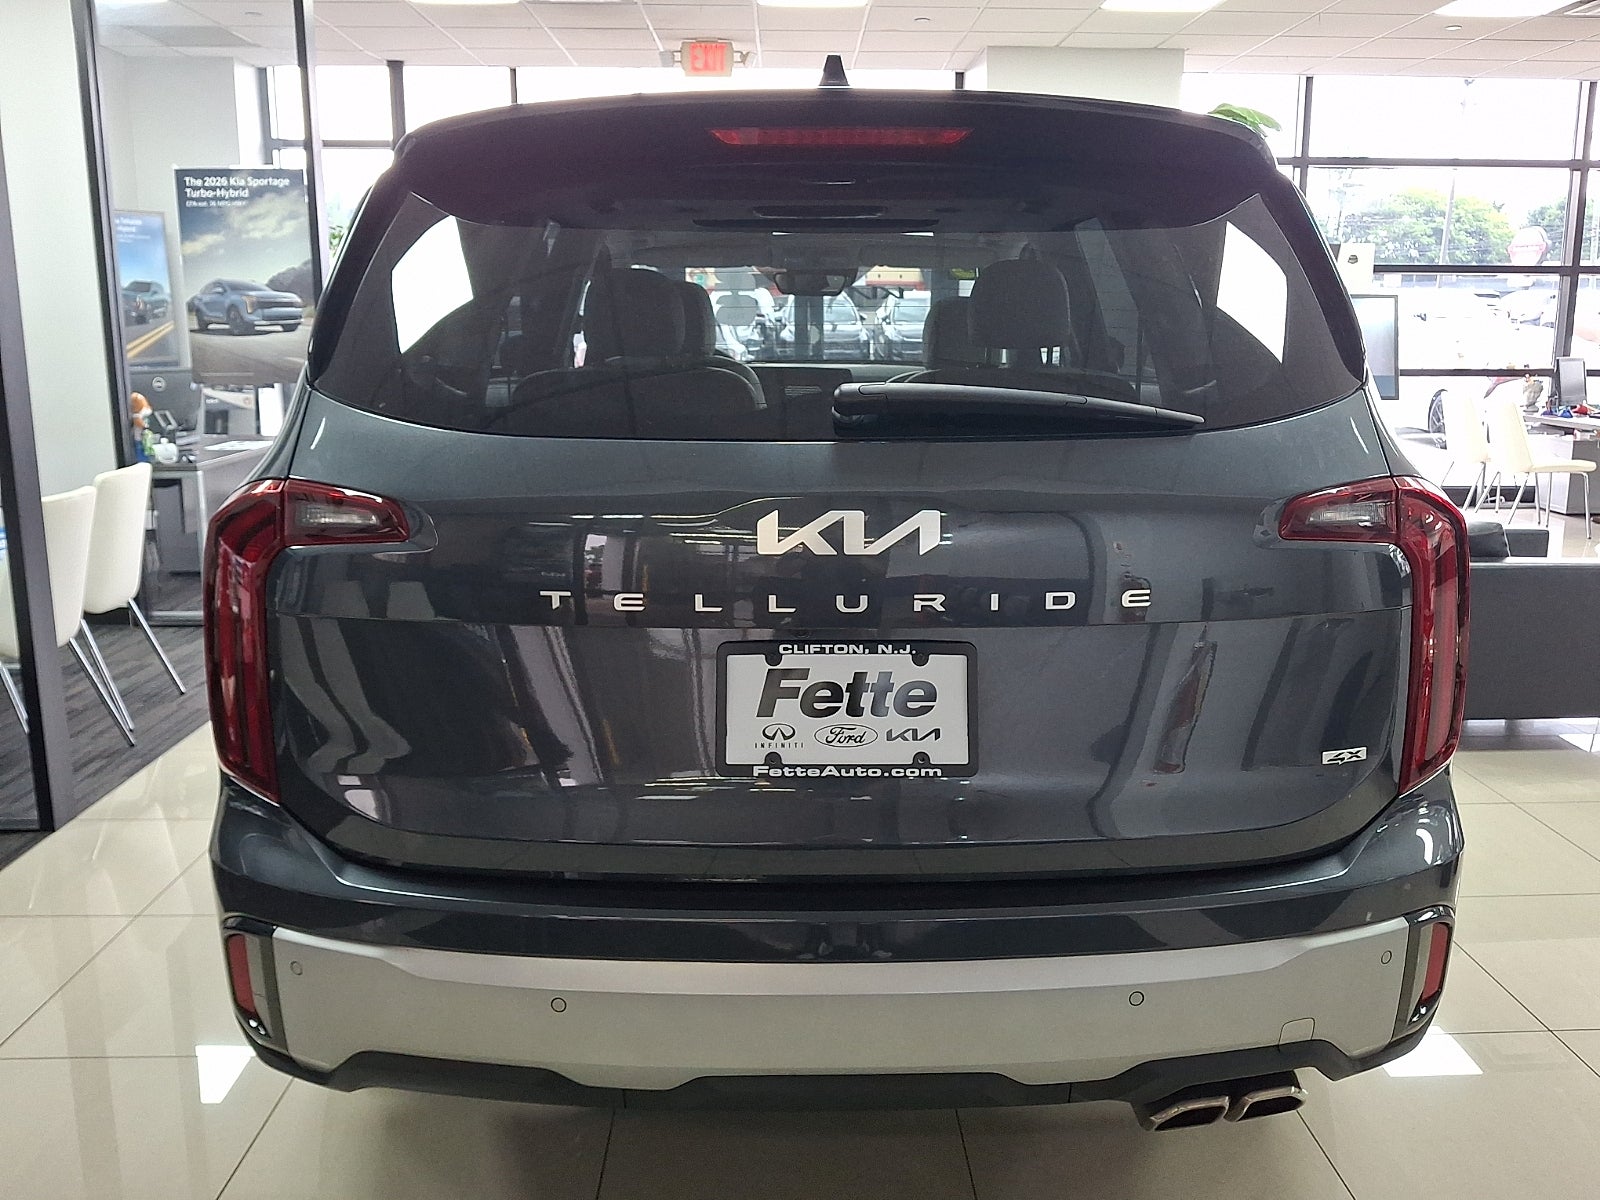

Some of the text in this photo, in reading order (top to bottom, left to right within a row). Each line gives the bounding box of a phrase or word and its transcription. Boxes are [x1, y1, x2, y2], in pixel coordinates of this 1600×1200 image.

[184, 176, 290, 189] The 2026 Kia Sportage
[184, 187, 249, 199] Turbo-Hybrid
[757, 509, 941, 556] KIA
[540, 588, 1152, 613] TELLURIDE
[778, 644, 916, 655] CLIFTON, N.J.
[755, 667, 938, 718] Fette
[825, 726, 868, 745] Ford
[886, 727, 941, 742] KIA
[753, 765, 942, 777] FetteAuto.com
